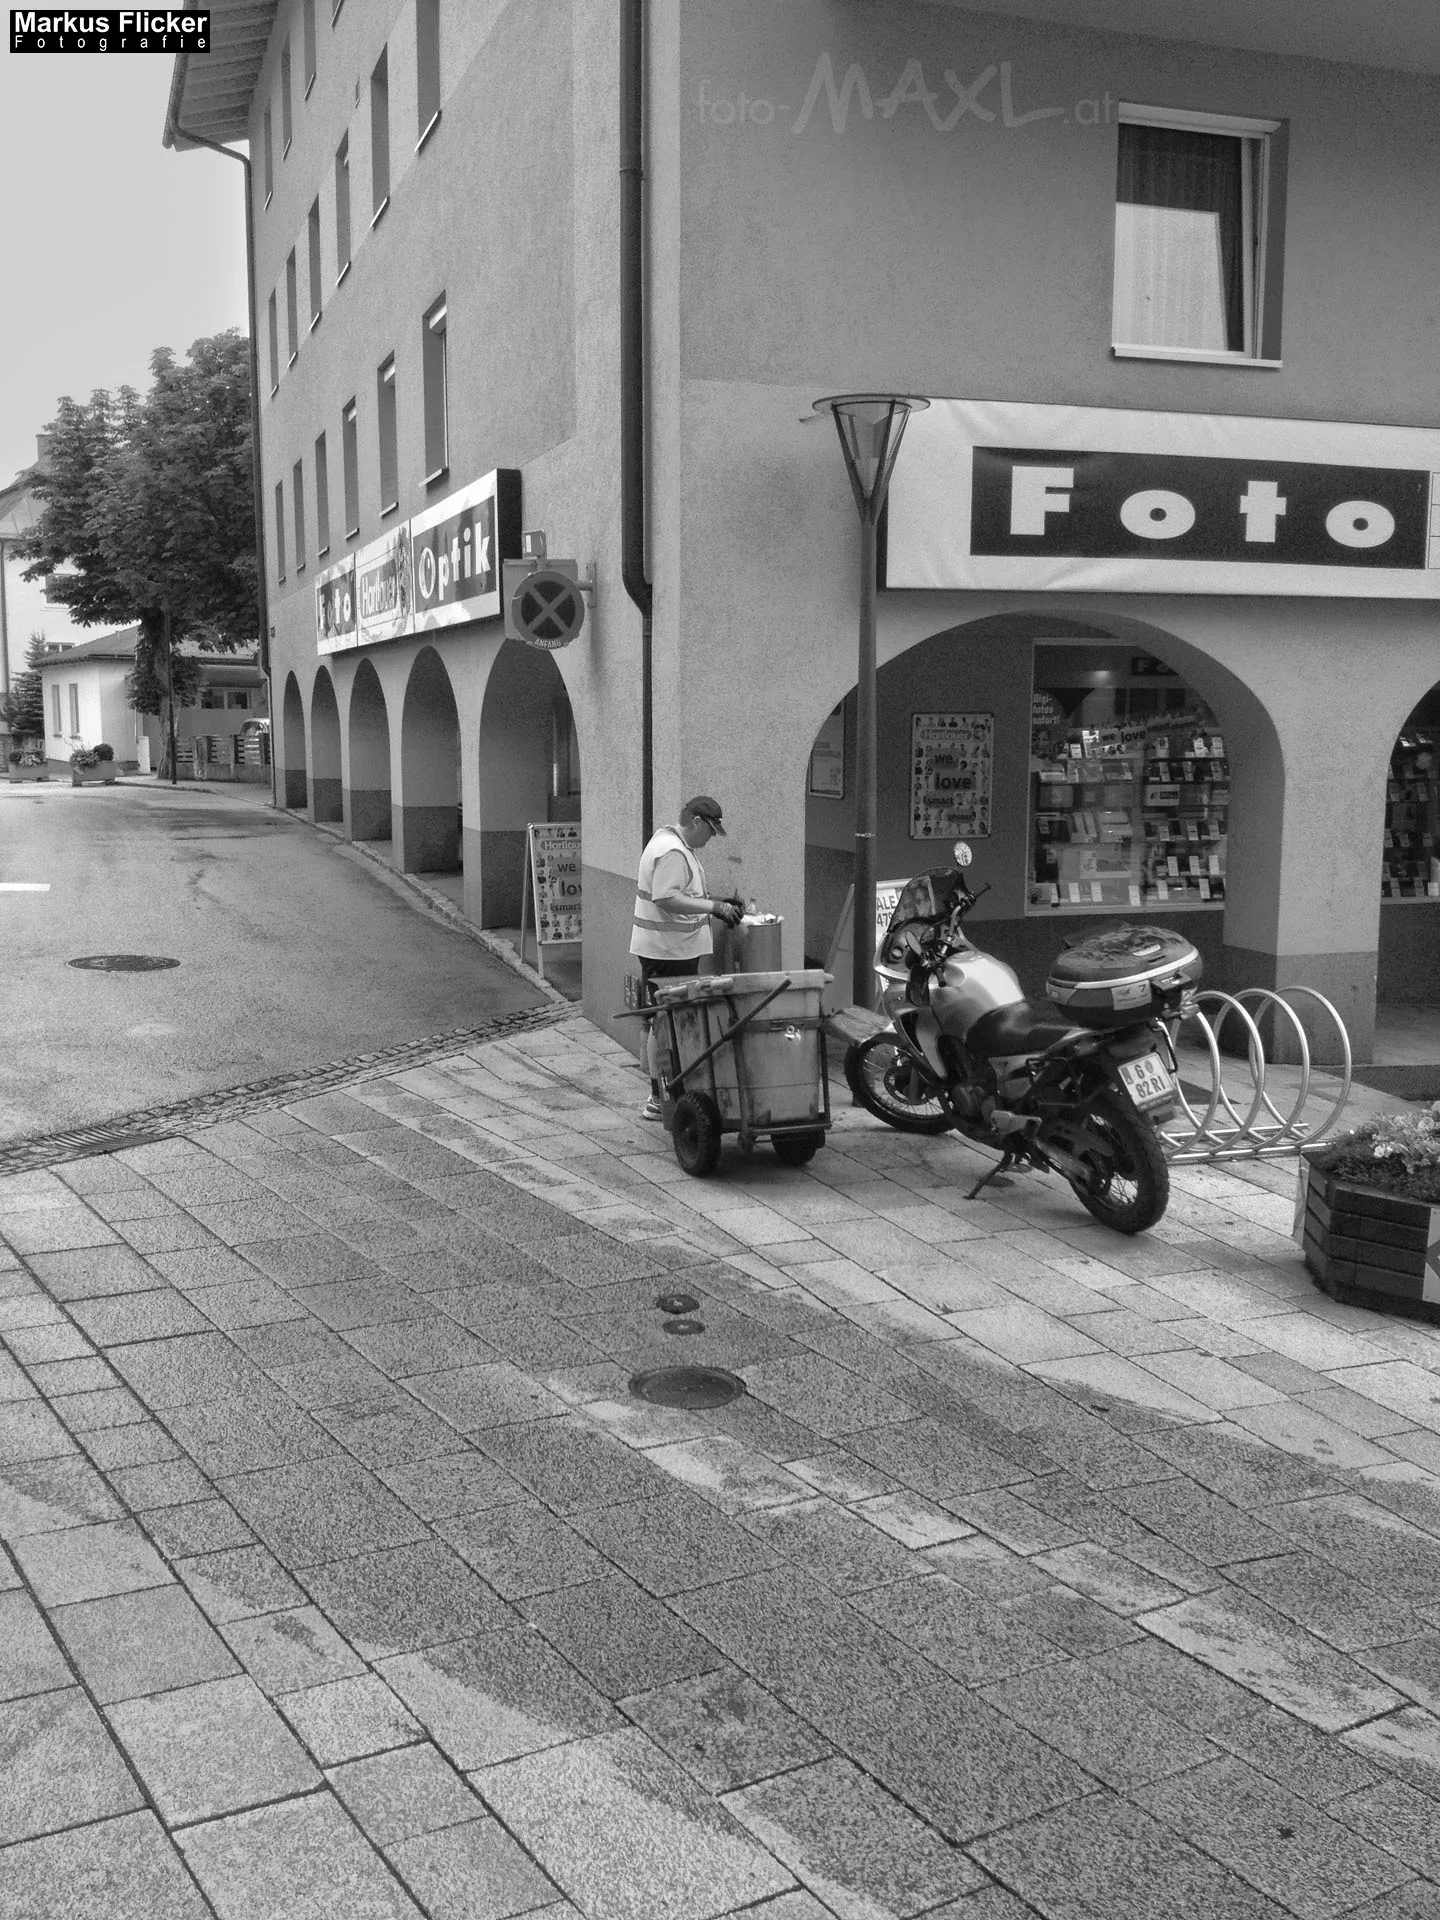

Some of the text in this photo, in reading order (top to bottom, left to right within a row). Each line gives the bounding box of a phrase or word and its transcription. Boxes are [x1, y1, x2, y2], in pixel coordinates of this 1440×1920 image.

[1010, 466, 1395, 548] Foto
[319, 587, 351, 630] Foto
[419, 521, 491, 601] Optik
[1101, 730, 1147, 743] we love
[934, 754, 953, 764] we
[936, 772, 972, 790] love
[544, 840, 581, 850] Hartlau
[557, 862, 576, 873] we
[561, 881, 582, 896] lo
